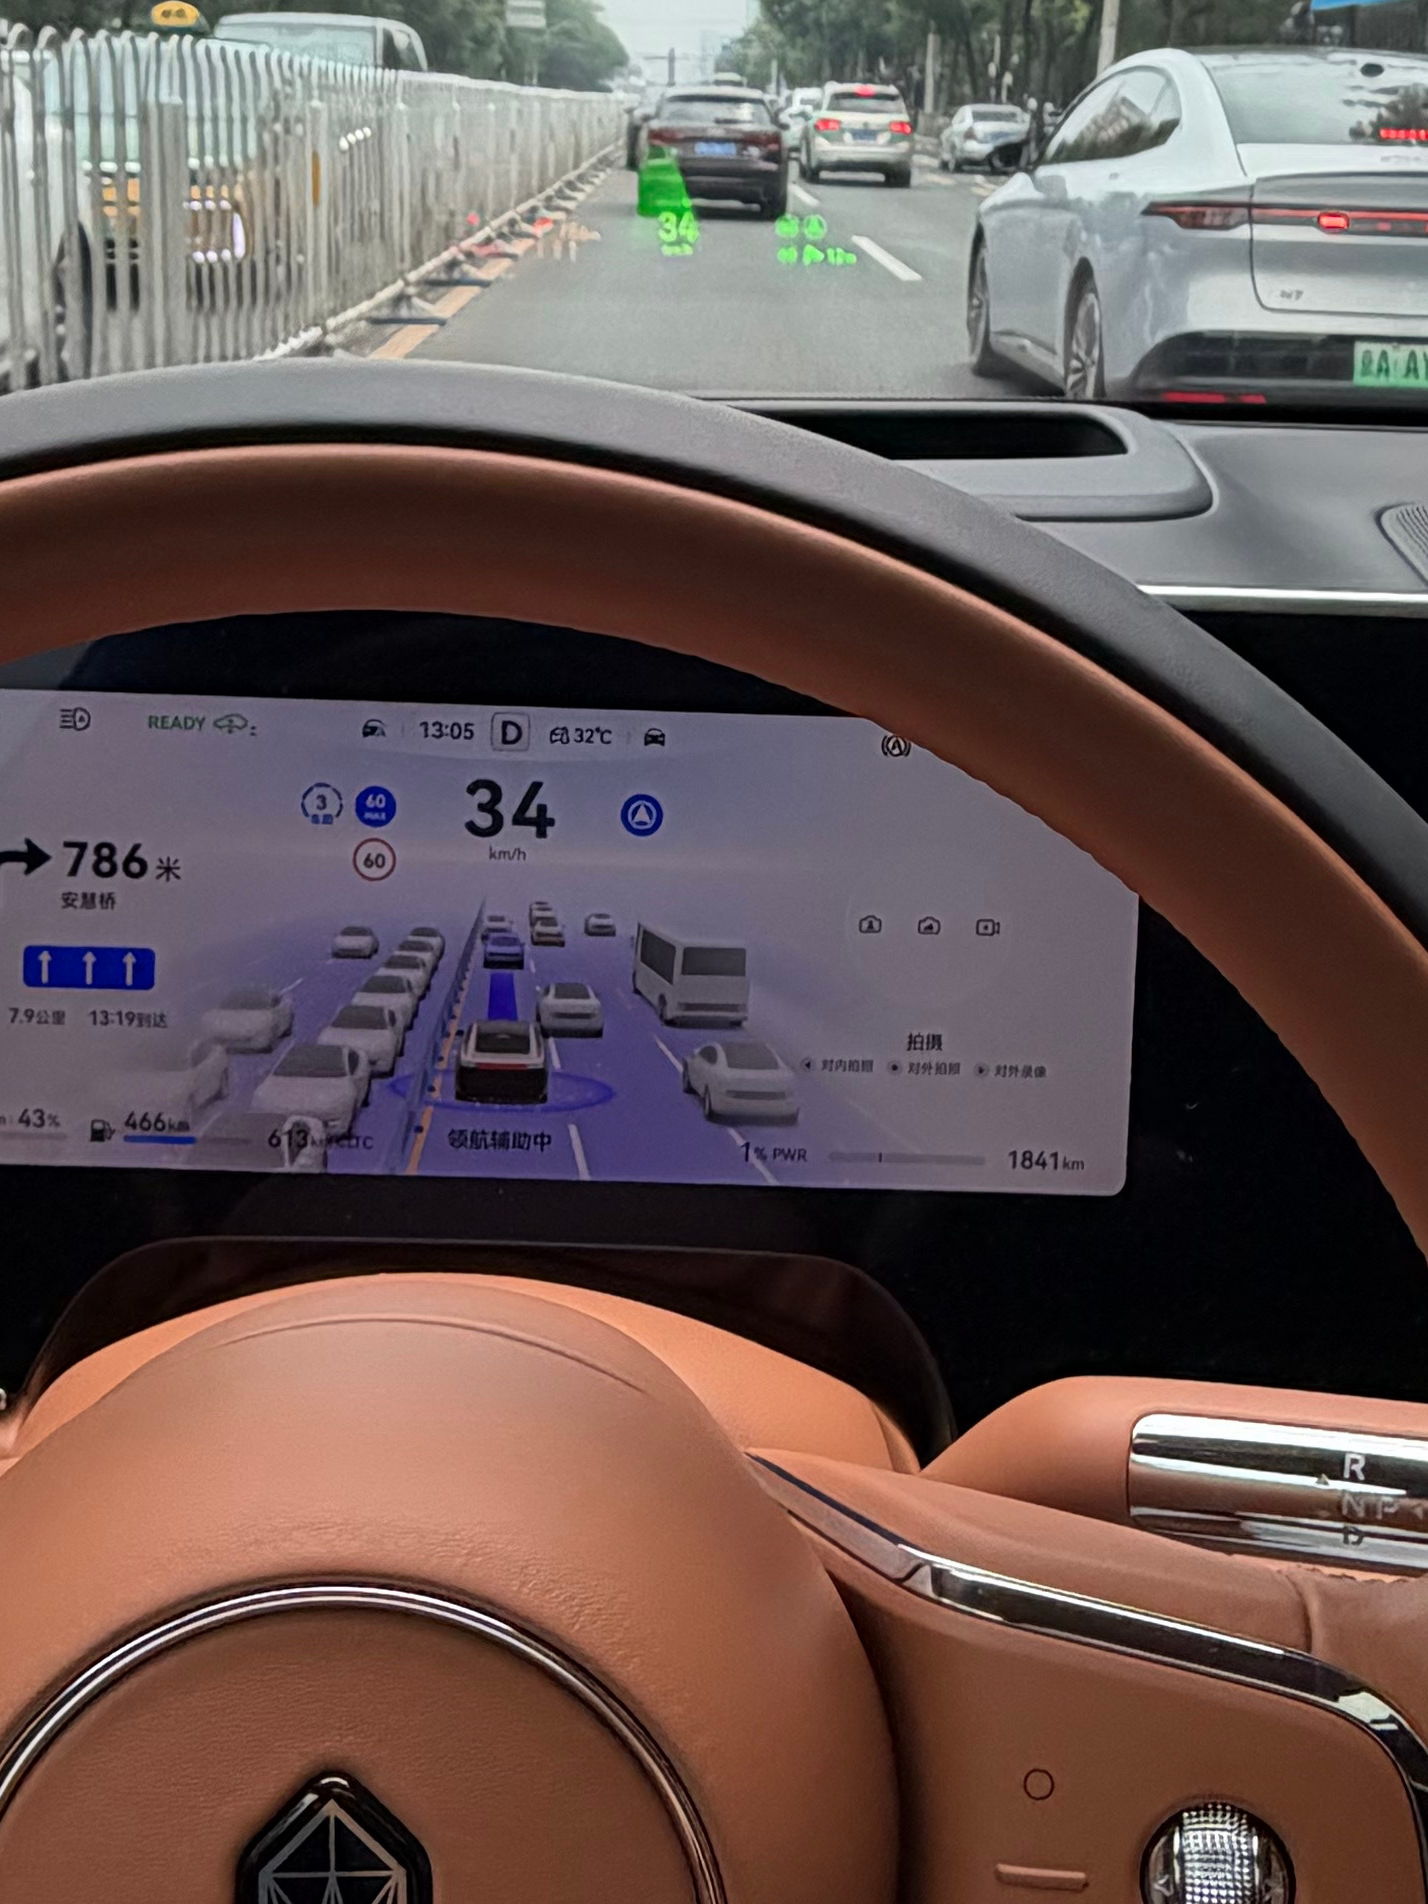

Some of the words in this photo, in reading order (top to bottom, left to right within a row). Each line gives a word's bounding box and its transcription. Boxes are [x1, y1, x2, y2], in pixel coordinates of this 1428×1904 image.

[148, 714, 206, 732] READY
[420, 720, 475, 741] 13:05
[501, 720, 524, 746] D
[573, 726, 613, 746] 32°C
[315, 794, 328, 811] 3
[365, 793, 387, 810] 60
[464, 779, 556, 839] 34
[363, 852, 386, 869] 60
[488, 846, 528, 862] km/h
[60, 891, 117, 911] 安慧桥
[17, 1108, 61, 1130] 43%
[447, 1128, 553, 1153] 领航辅助中
[772, 1148, 808, 1163] PWR
[1343, 1453, 1366, 1481] R
[1341, 1490, 1366, 1517] N
[1375, 1496, 1399, 1520] P
